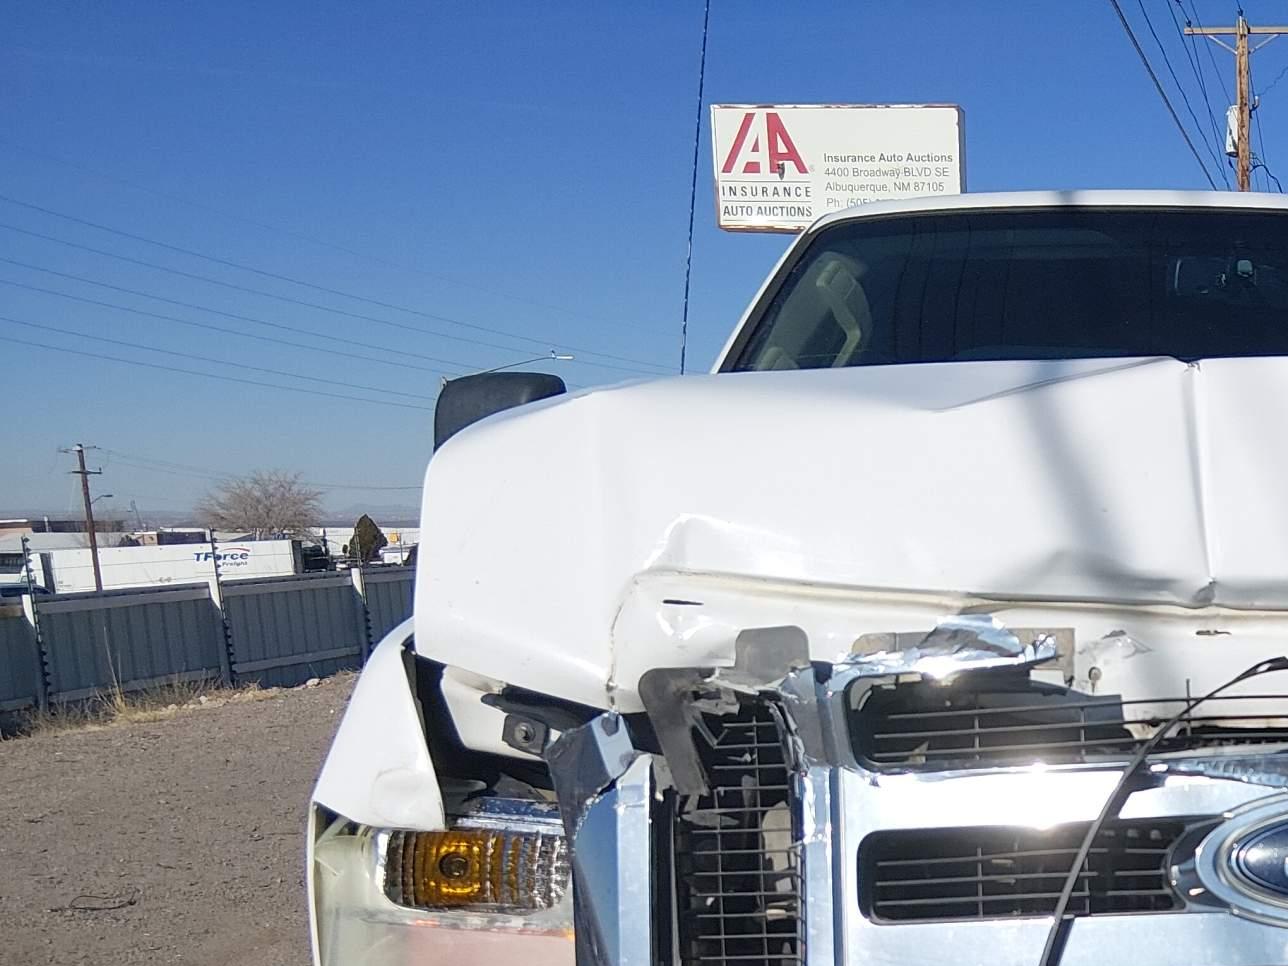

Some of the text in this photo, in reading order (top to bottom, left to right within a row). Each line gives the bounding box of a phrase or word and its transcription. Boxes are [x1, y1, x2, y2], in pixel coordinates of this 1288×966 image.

[824, 153, 953, 163] Insurance Auto Auctions
[824, 167, 950, 179] 4400 Broadway BLVD SE
[722, 186, 811, 197] INSURANCE
[825, 182, 945, 193] Albuquerque, NM 87105
[826, 198, 843, 208] Ph:
[723, 206, 812, 217] AUTO AUCTIONS
[194, 552, 249, 561] TForce
